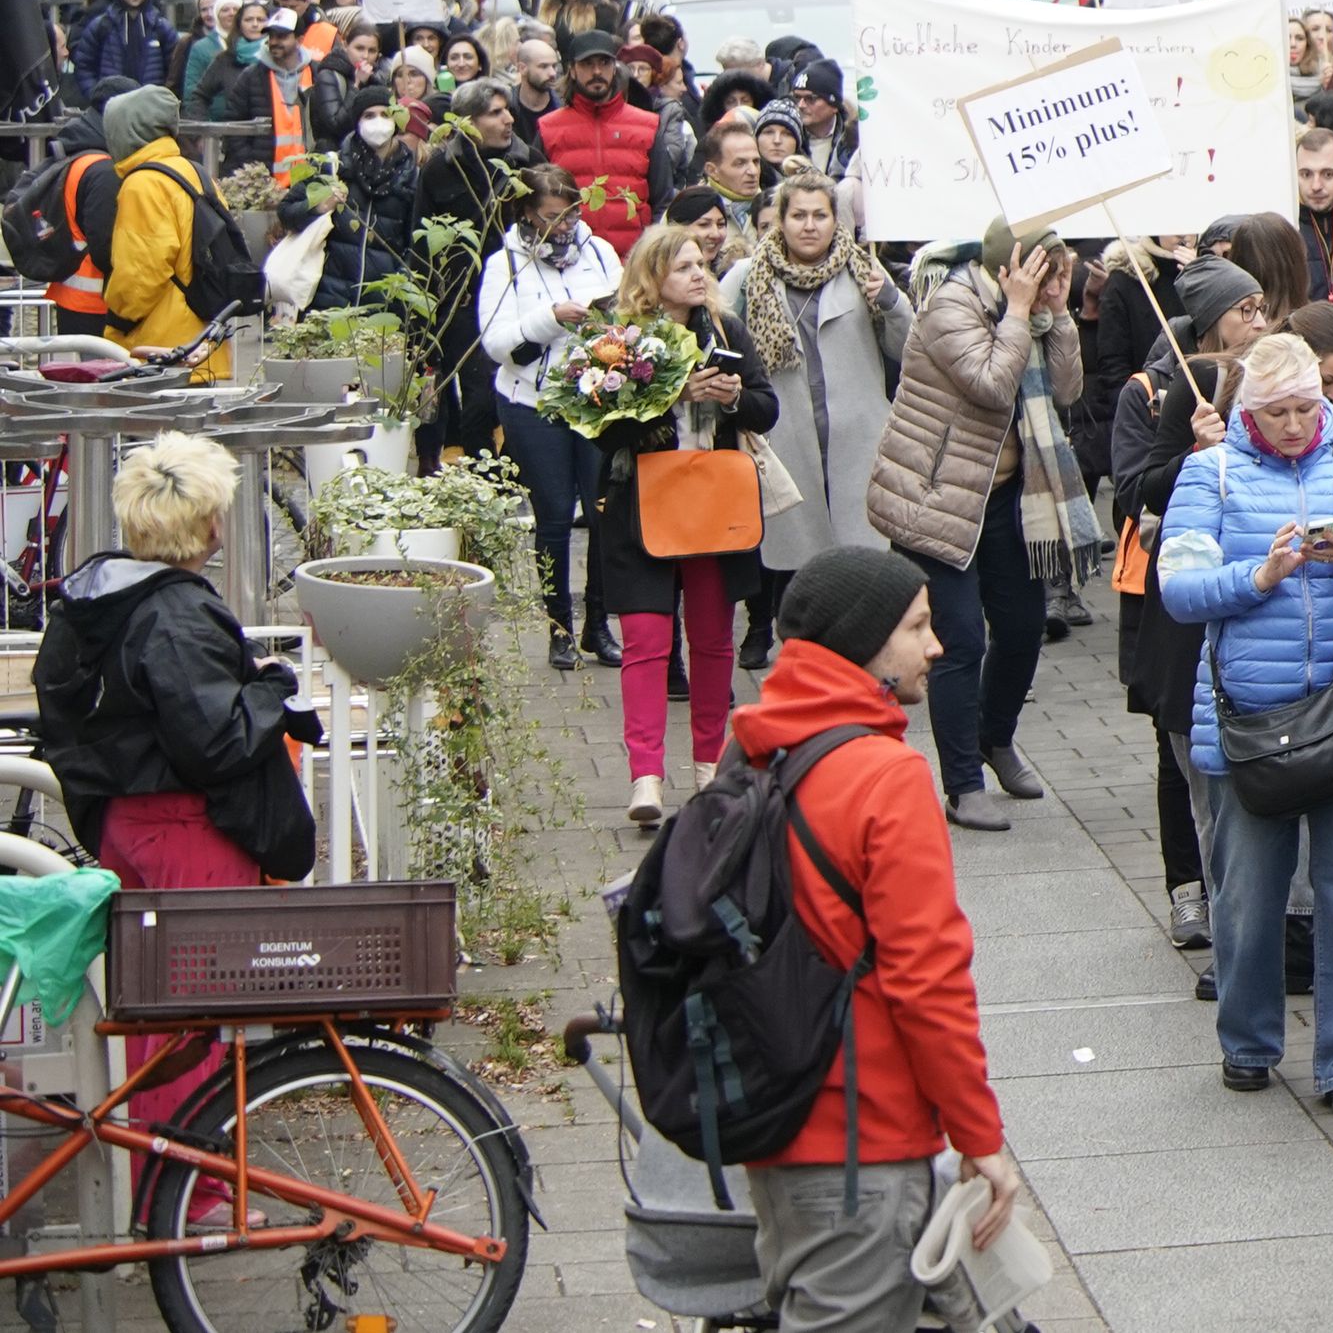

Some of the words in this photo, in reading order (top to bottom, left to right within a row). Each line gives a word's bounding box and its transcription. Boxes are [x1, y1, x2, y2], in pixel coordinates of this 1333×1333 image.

[1004, 27, 1071, 56] Kinder
[986, 76, 1131, 141] Minimum:
[1005, 135, 1067, 175] 15%
[1074, 108, 1140, 158] plus!
[259, 941, 312, 953] EIGENTUM
[252, 956, 299, 968] KONSUM
